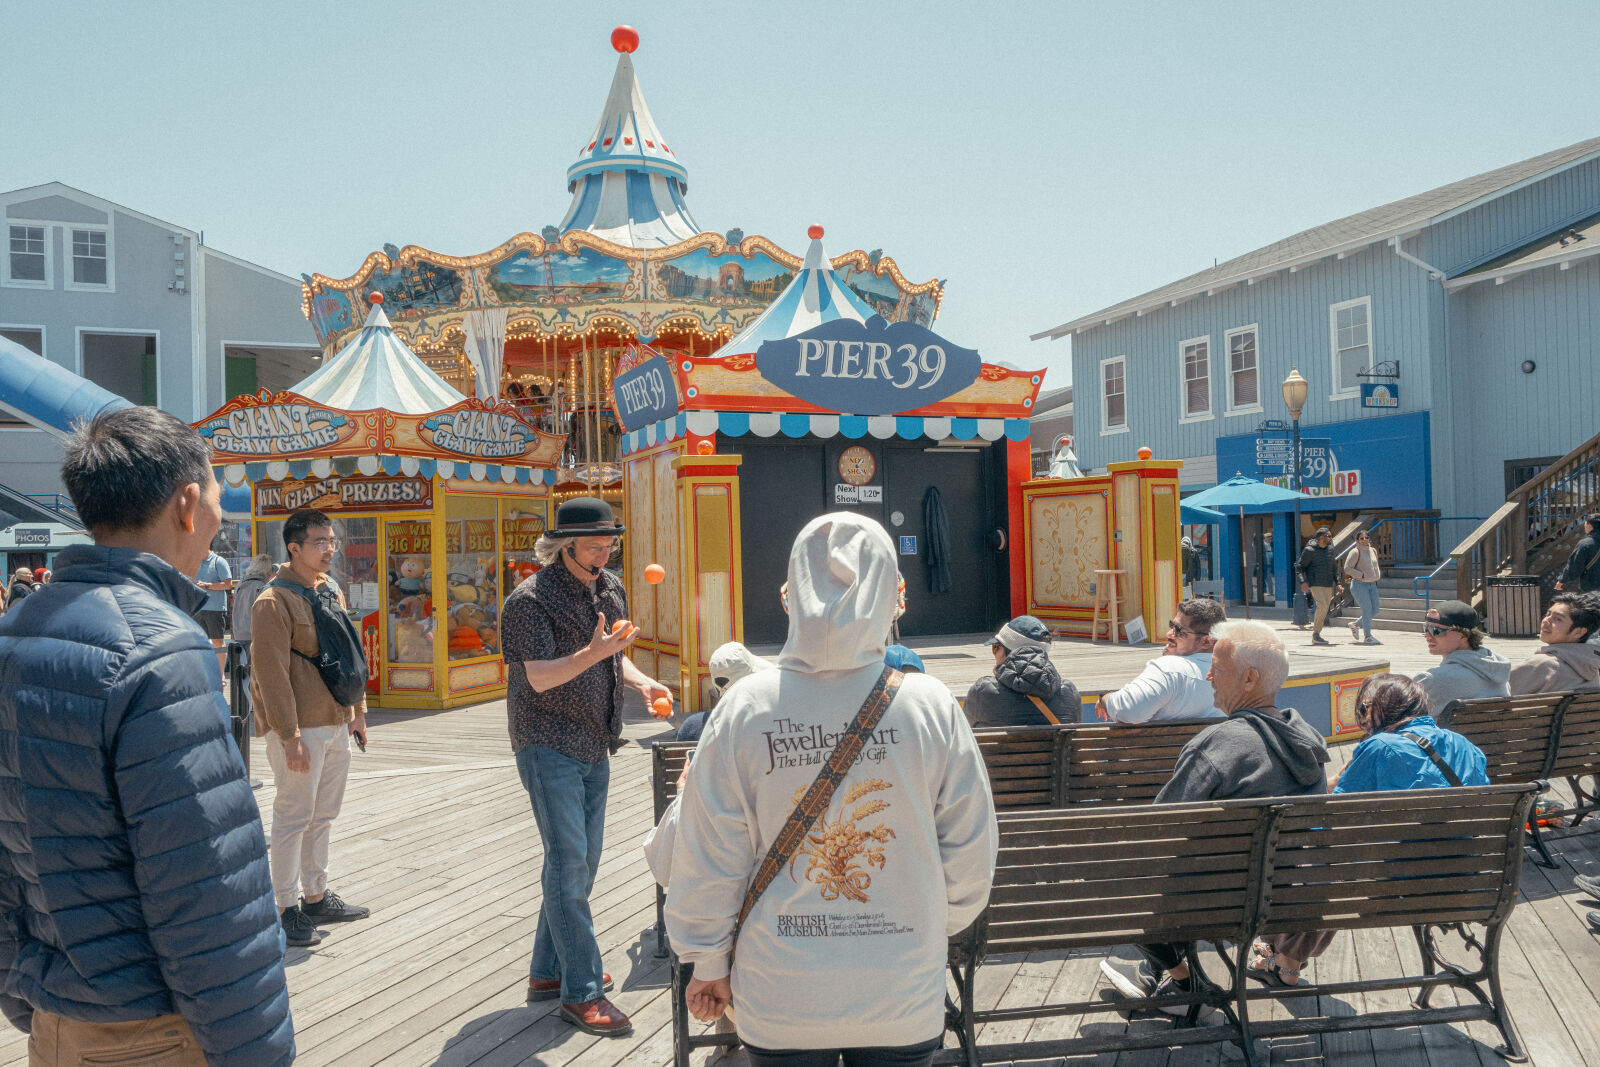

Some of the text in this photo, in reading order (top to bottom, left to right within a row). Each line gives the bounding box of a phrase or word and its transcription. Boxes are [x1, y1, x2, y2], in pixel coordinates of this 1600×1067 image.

[795, 338, 946, 389] PIER 39
[621, 368, 665, 414] PIER 39
[209, 419, 226, 429] THE
[229, 404, 312, 439] GIANT
[438, 415, 453, 423] THE
[453, 410, 516, 441] GIANT
[212, 425, 339, 454] CLAW GAME
[433, 429, 525, 457] CLAW GAME
[1304, 447, 1325, 456] PIER
[1302, 457, 1327, 478] 39
[258, 478, 421, 510] WIN GIANT PRIZES!
[863, 490, 877, 498] 1:20
[388, 537, 460, 553] BIG PRES
[469, 533, 544, 550] BIG RIZE
[773, 718, 804, 734] The
[762, 722, 850, 775] Jeweller'
[777, 756, 797, 769] The
[798, 751, 821, 766] Hull
[866, 747, 888, 765] Gift
[777, 915, 826, 926] BRITISH
[777, 926, 829, 937] MUSEUM
